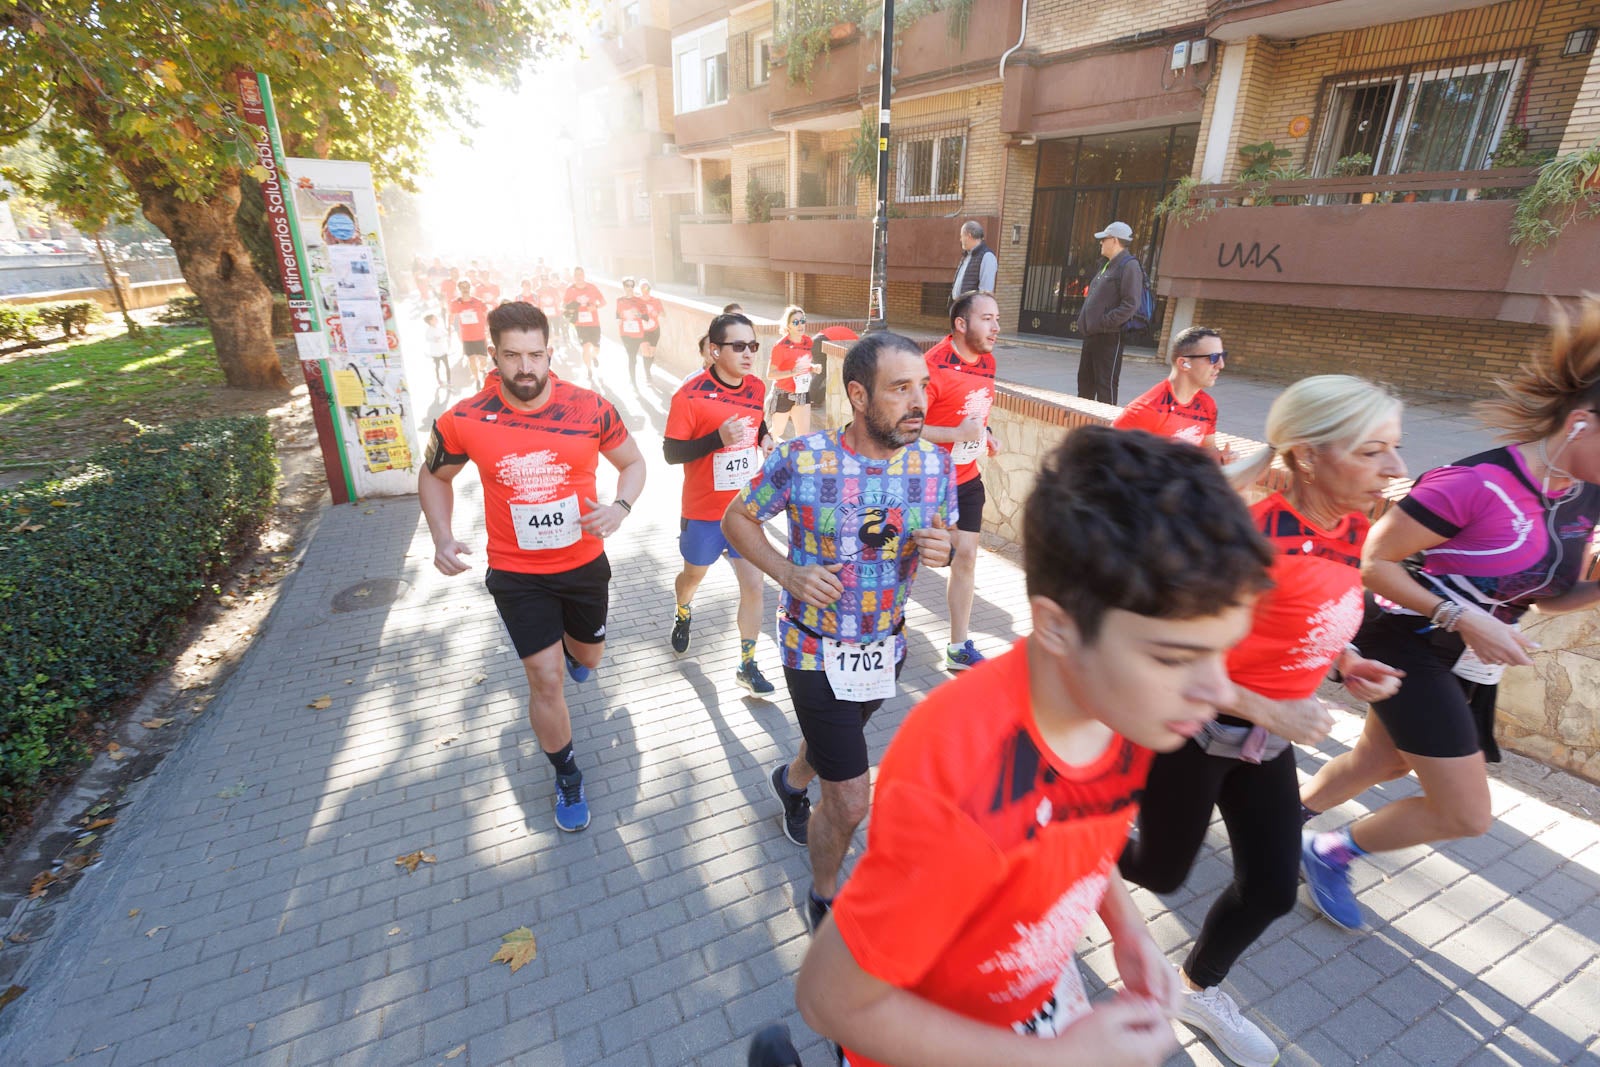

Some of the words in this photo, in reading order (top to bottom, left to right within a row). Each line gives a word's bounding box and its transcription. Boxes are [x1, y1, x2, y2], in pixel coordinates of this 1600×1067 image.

[1114, 167, 1122, 181] 2
[726, 457, 749, 472] 478
[528, 512, 564, 528] 448
[836, 651, 884, 672] 1702
